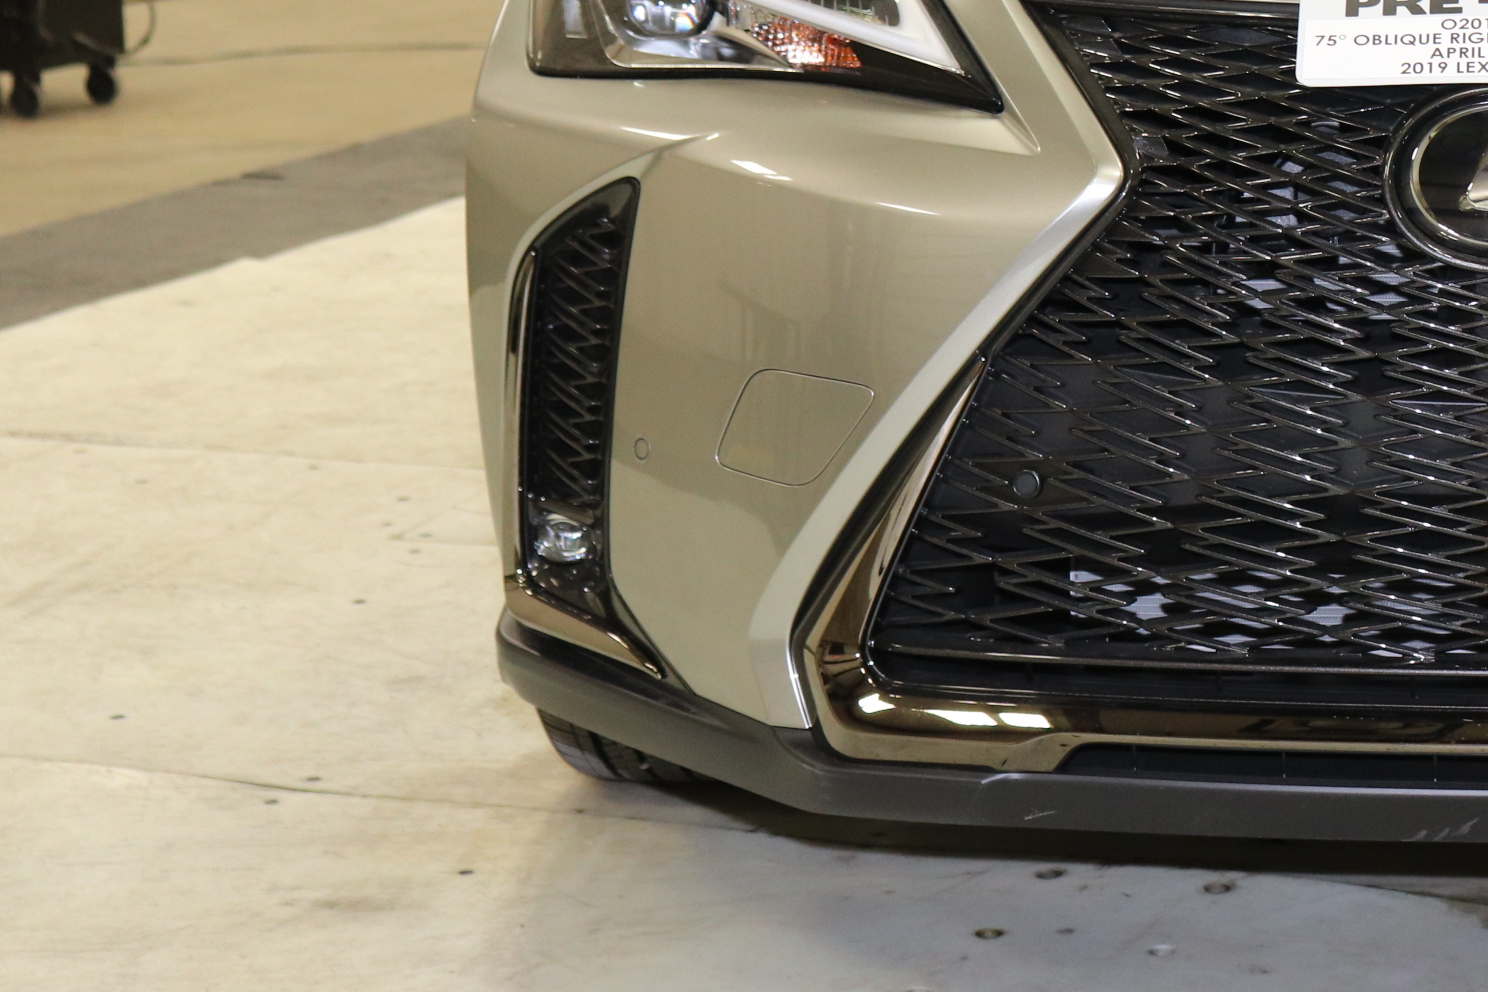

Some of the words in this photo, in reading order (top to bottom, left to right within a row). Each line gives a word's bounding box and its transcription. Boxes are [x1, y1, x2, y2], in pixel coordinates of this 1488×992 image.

[1353, 33, 1442, 46] OBLIQUE
[1430, 47, 1486, 59] APRIL
[1400, 62, 1448, 74] 2019
